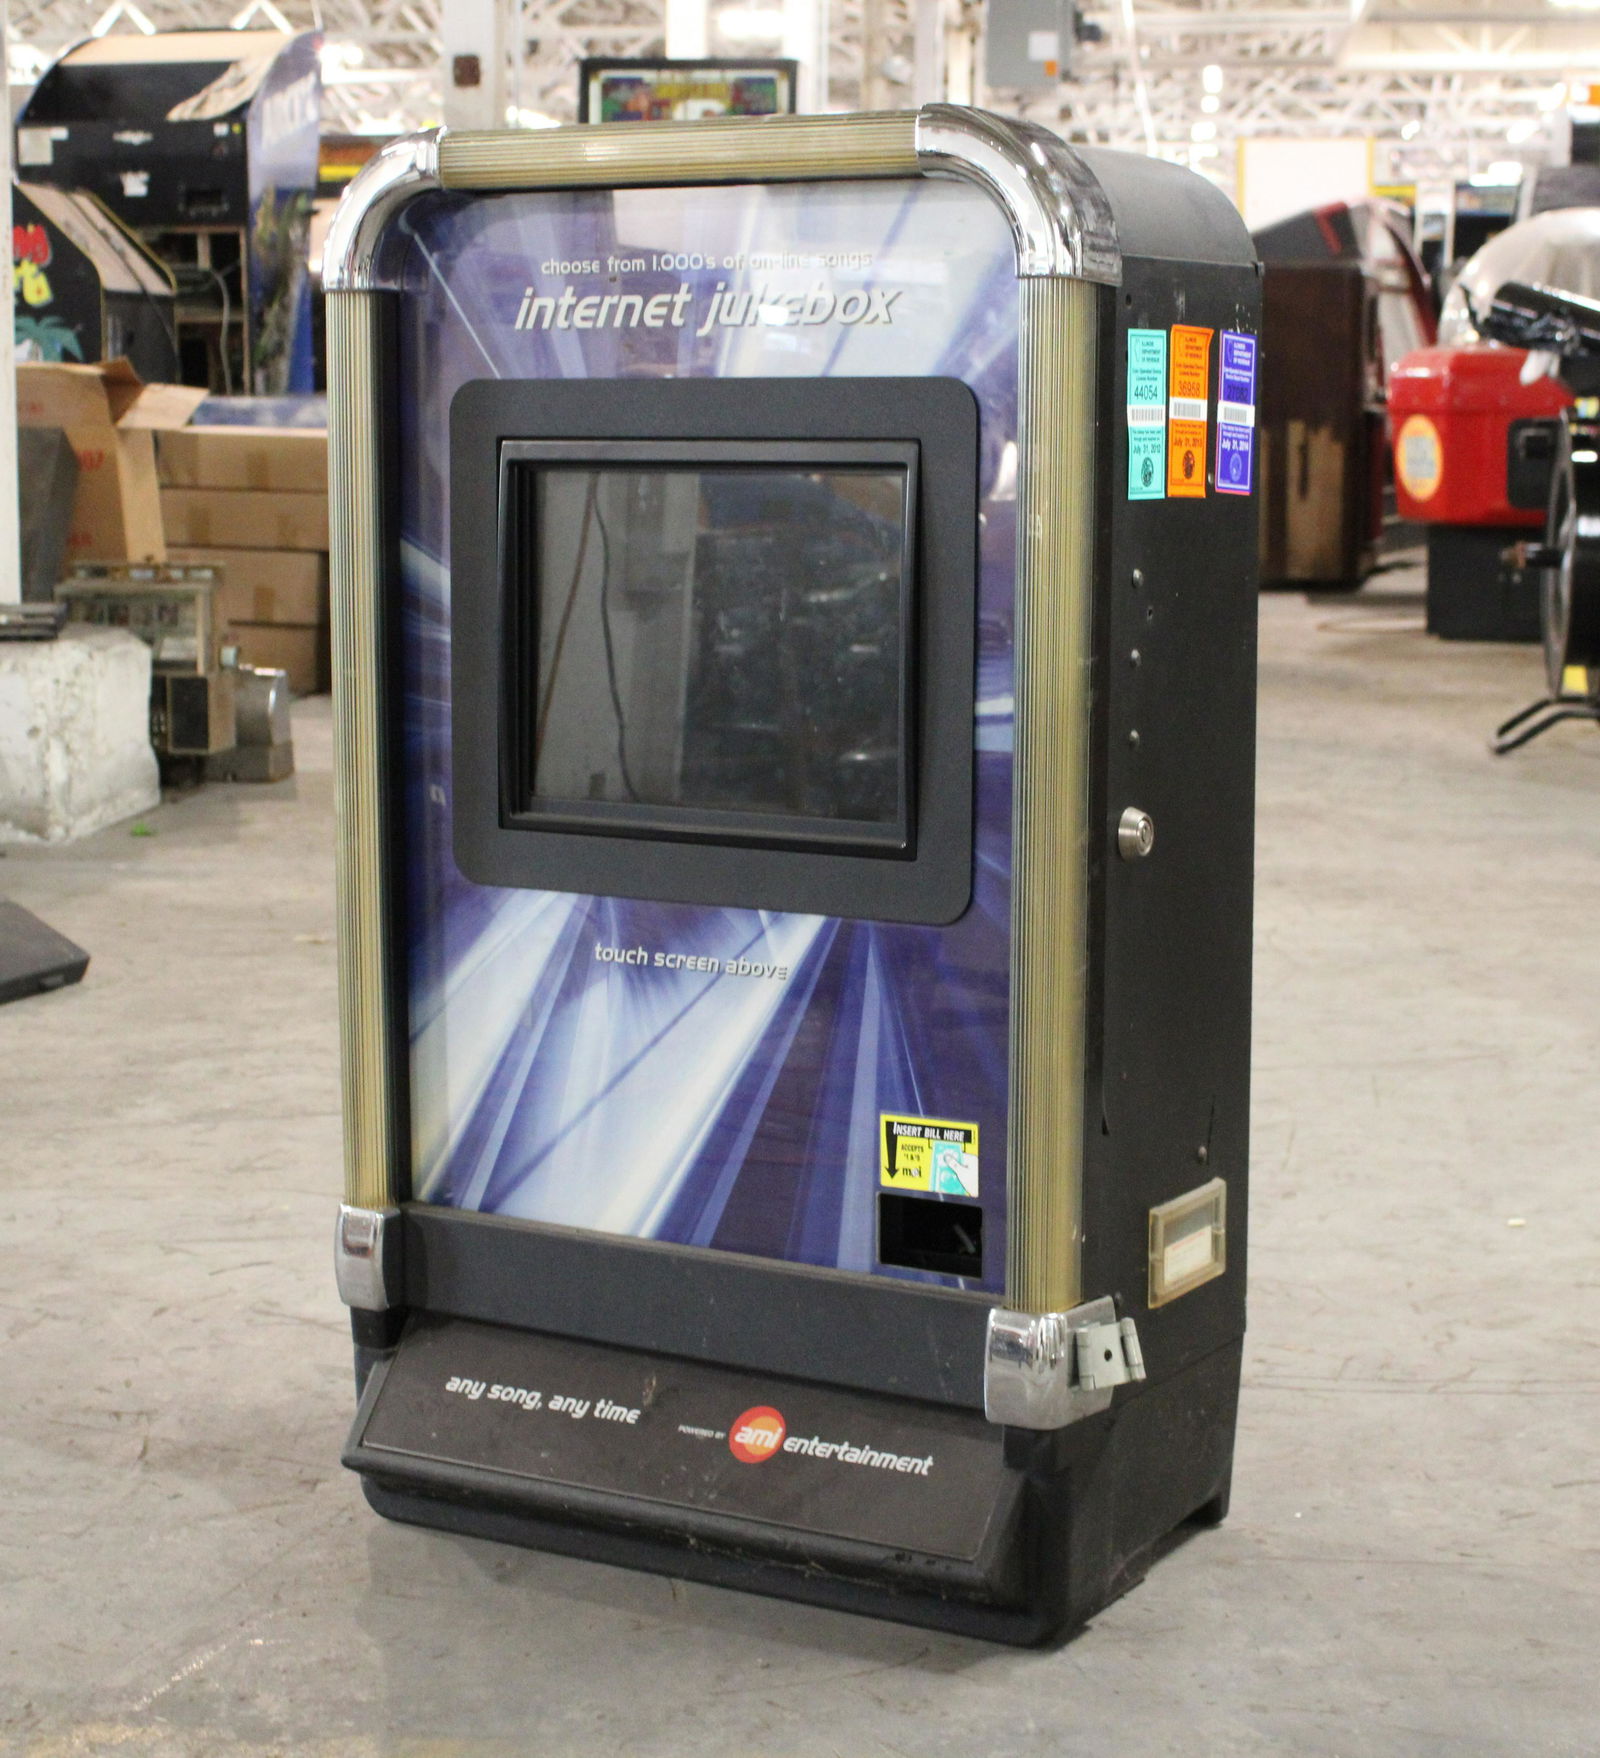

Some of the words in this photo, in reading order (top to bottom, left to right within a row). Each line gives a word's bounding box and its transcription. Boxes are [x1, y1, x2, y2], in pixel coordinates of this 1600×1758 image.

[541, 257, 601, 275] choose
[607, 256, 645, 273] from
[723, 253, 744, 271] of
[814, 252, 873, 271] songs
[514, 282, 692, 330] internet
[696, 281, 902, 337] jukebox
[1134, 385, 1158, 401] 44054
[1222, 438, 1231, 451] July
[595, 942, 649, 965] touch
[654, 951, 720, 973] screen
[725, 957, 789, 980] above
[893, 1121, 922, 1136] INSERT
[924, 1127, 941, 1139] BILL
[943, 1129, 965, 1142] HERE
[901, 1143, 924, 1153] ACCEPTS
[445, 1376, 486, 1400] any
[487, 1383, 543, 1410] song,
[547, 1394, 591, 1419] any
[593, 1398, 641, 1424] time
[678, 1424, 714, 1438] POWERED
[714, 1431, 727, 1440] BY
[734, 1425, 783, 1449] ami
[782, 1435, 935, 1476] entertainment
